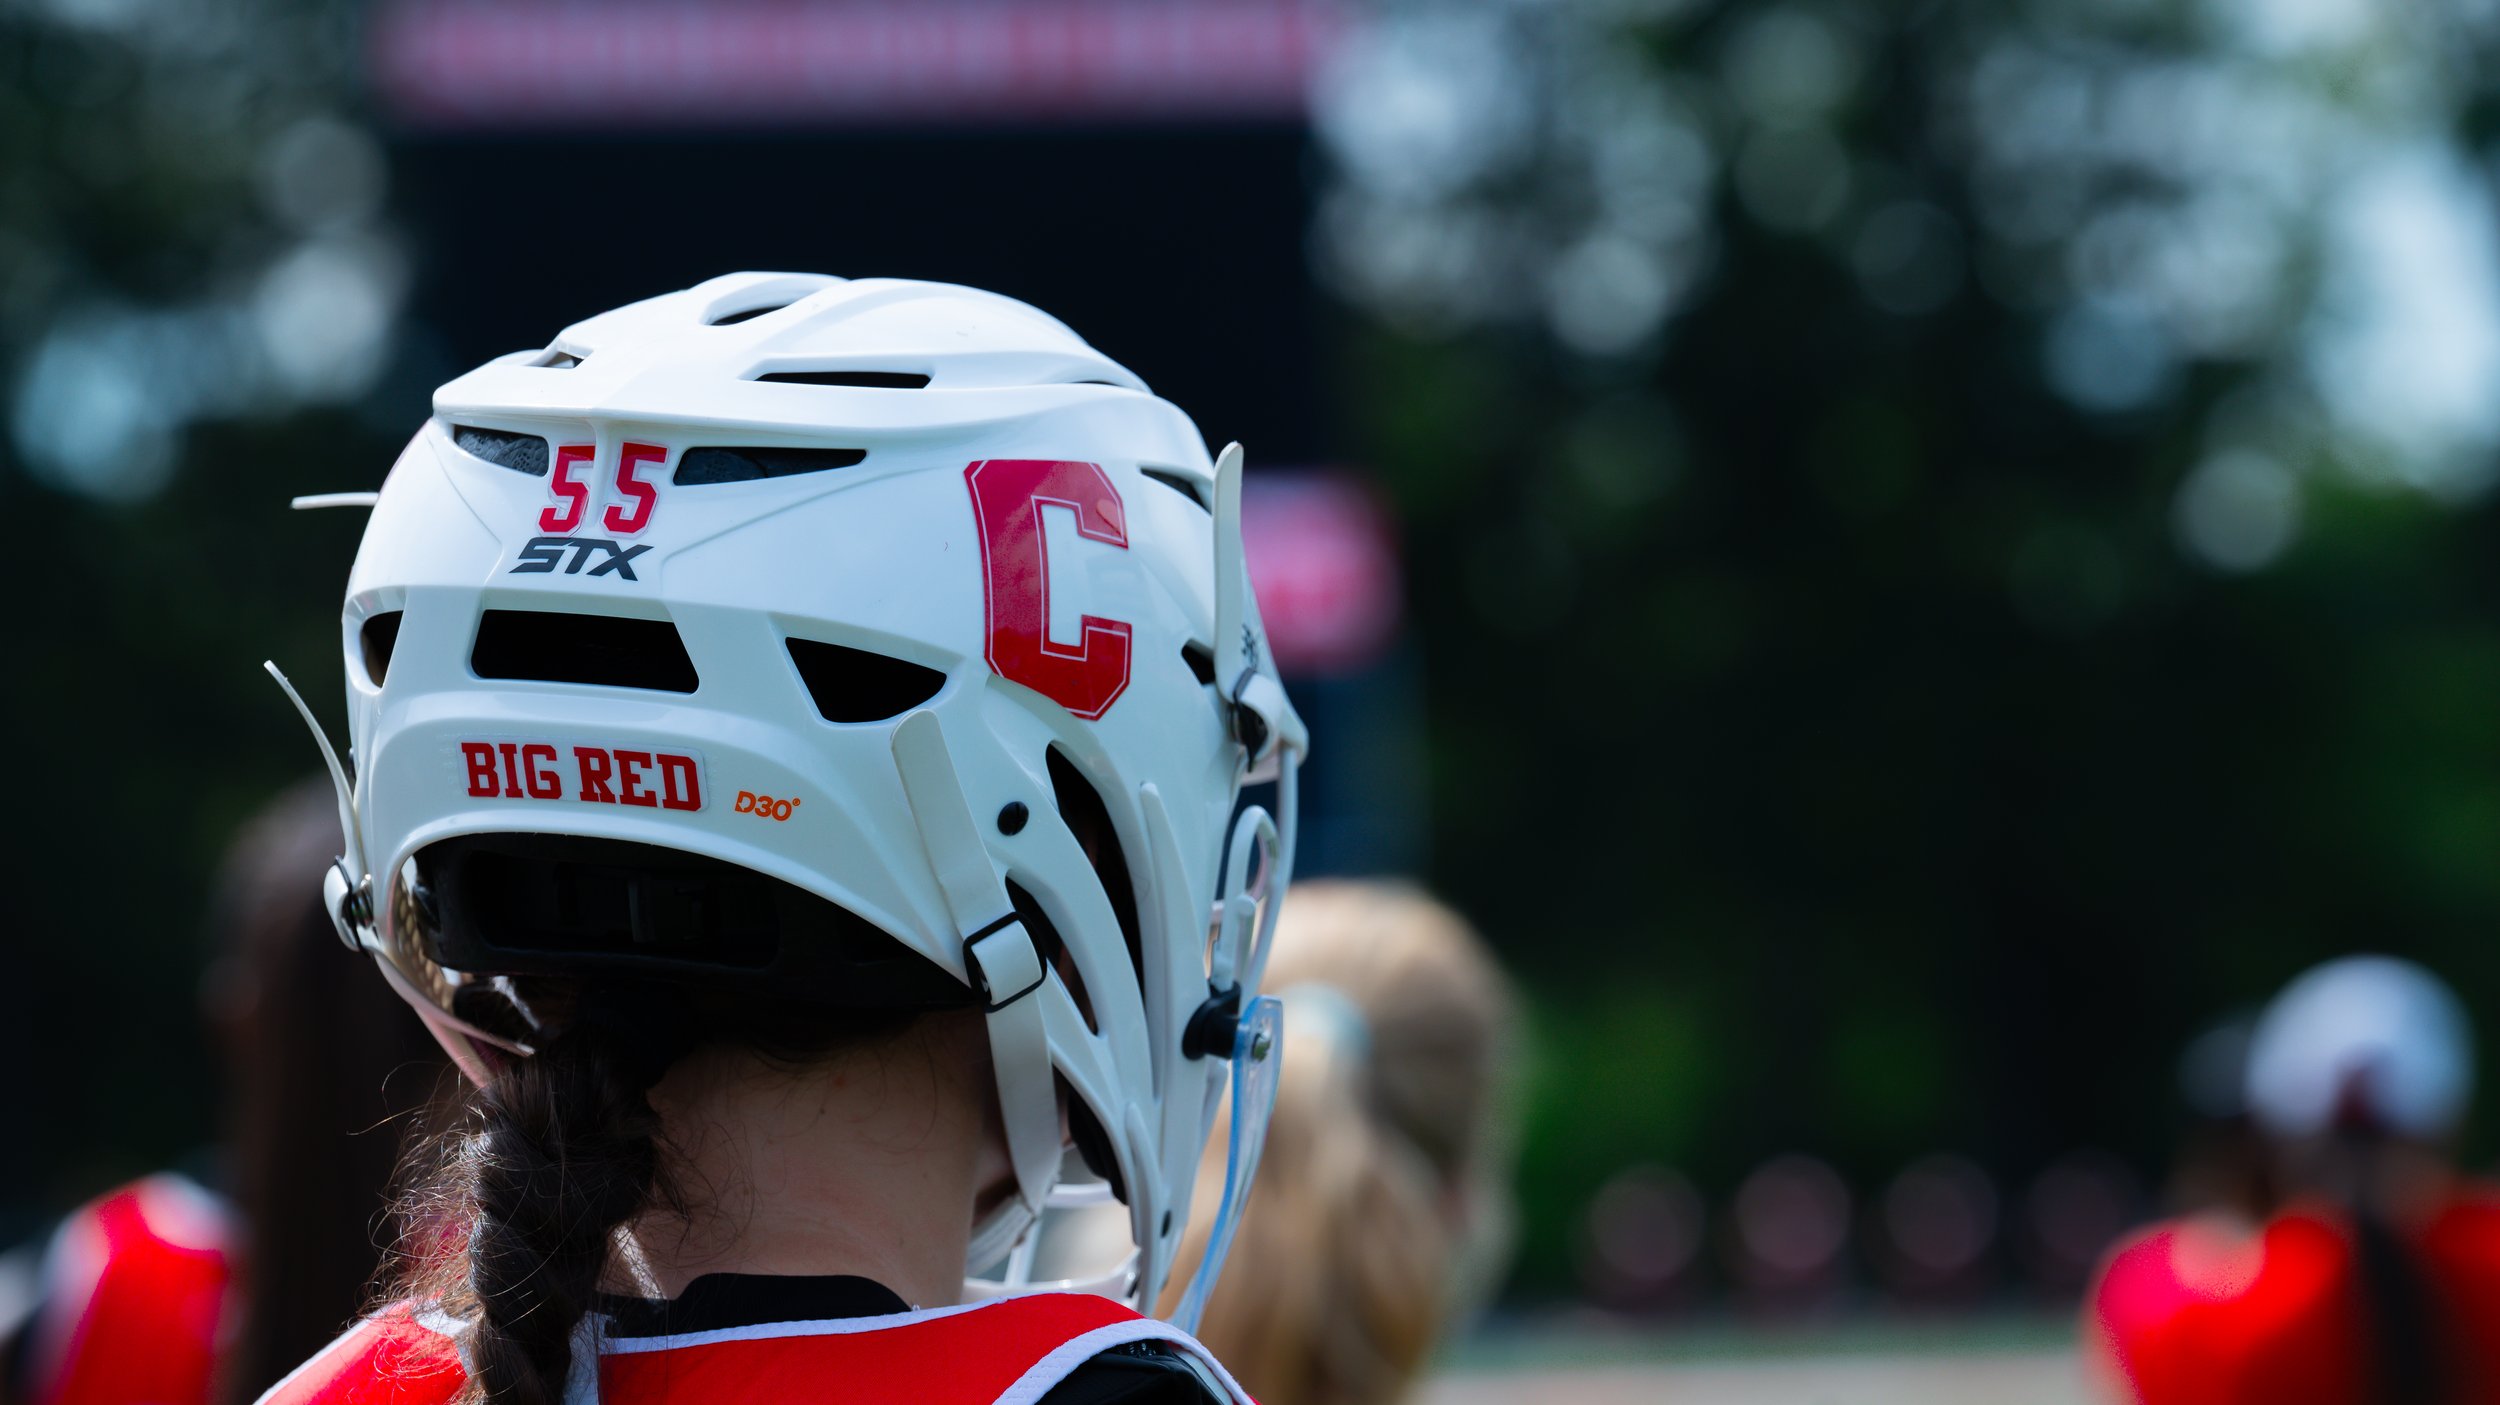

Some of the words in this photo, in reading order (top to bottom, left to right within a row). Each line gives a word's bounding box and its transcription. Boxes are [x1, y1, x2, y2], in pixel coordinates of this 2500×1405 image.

[538, 441, 668, 534] 55
[509, 536, 655, 581] STX
[963, 459, 1133, 722] C
[461, 741, 562, 800] BIG
[573, 746, 702, 812] RED
